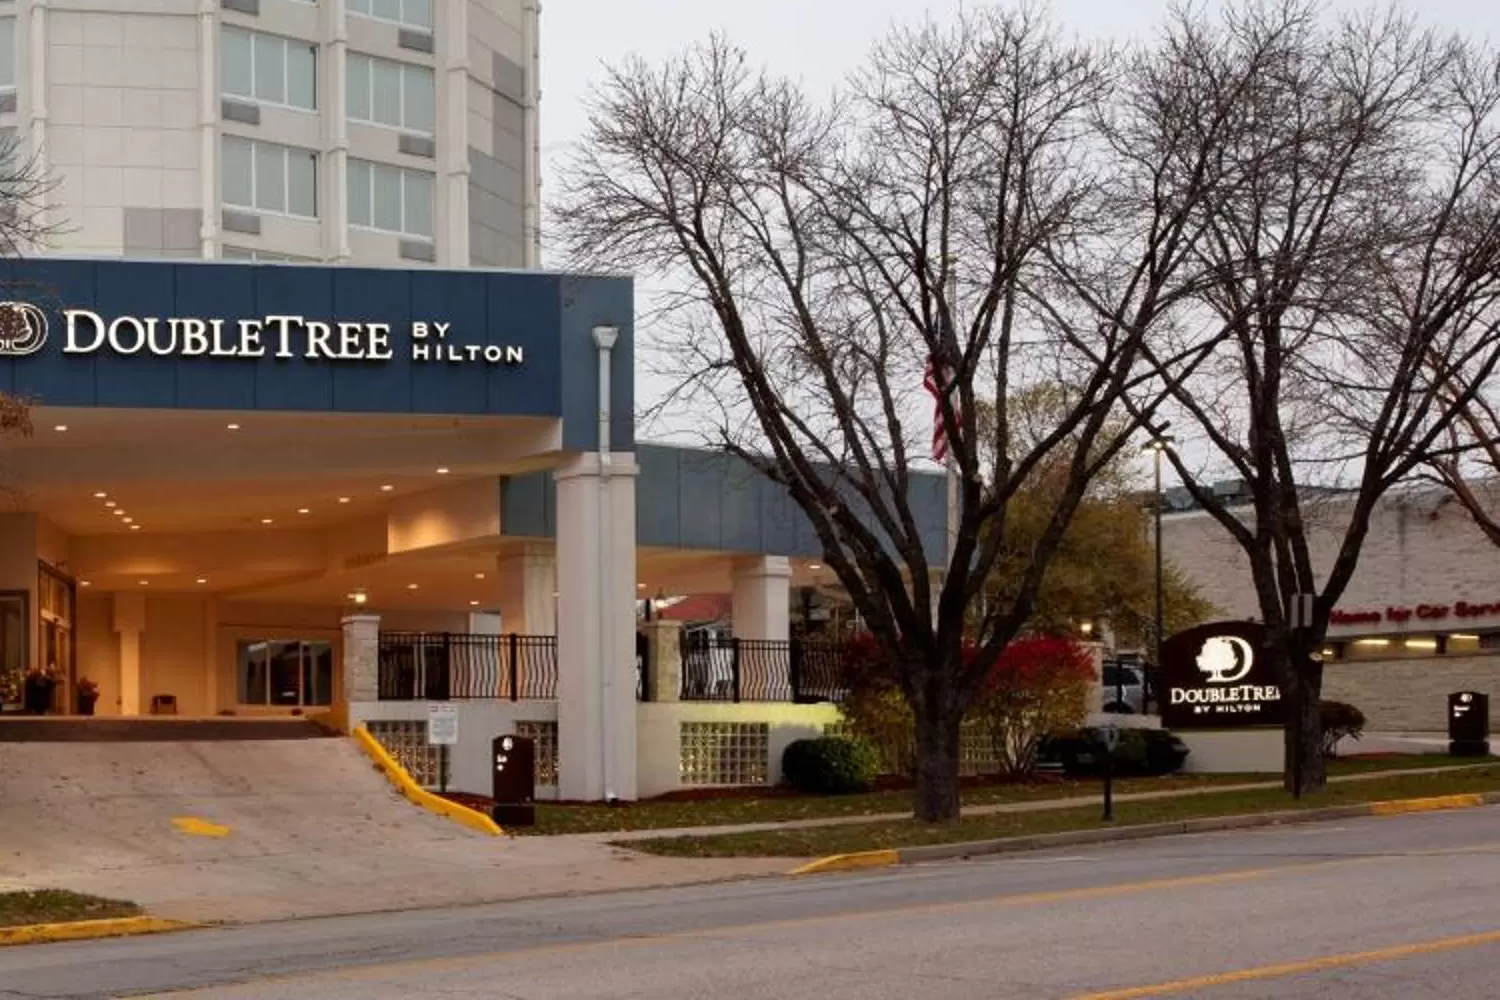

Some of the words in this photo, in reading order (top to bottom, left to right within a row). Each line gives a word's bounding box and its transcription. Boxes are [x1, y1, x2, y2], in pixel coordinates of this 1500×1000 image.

[412, 321, 450, 338] BY
[412, 344, 524, 362] HILTON
[1193, 705, 1211, 714] BY
[1215, 703, 1261, 713] HILTON
